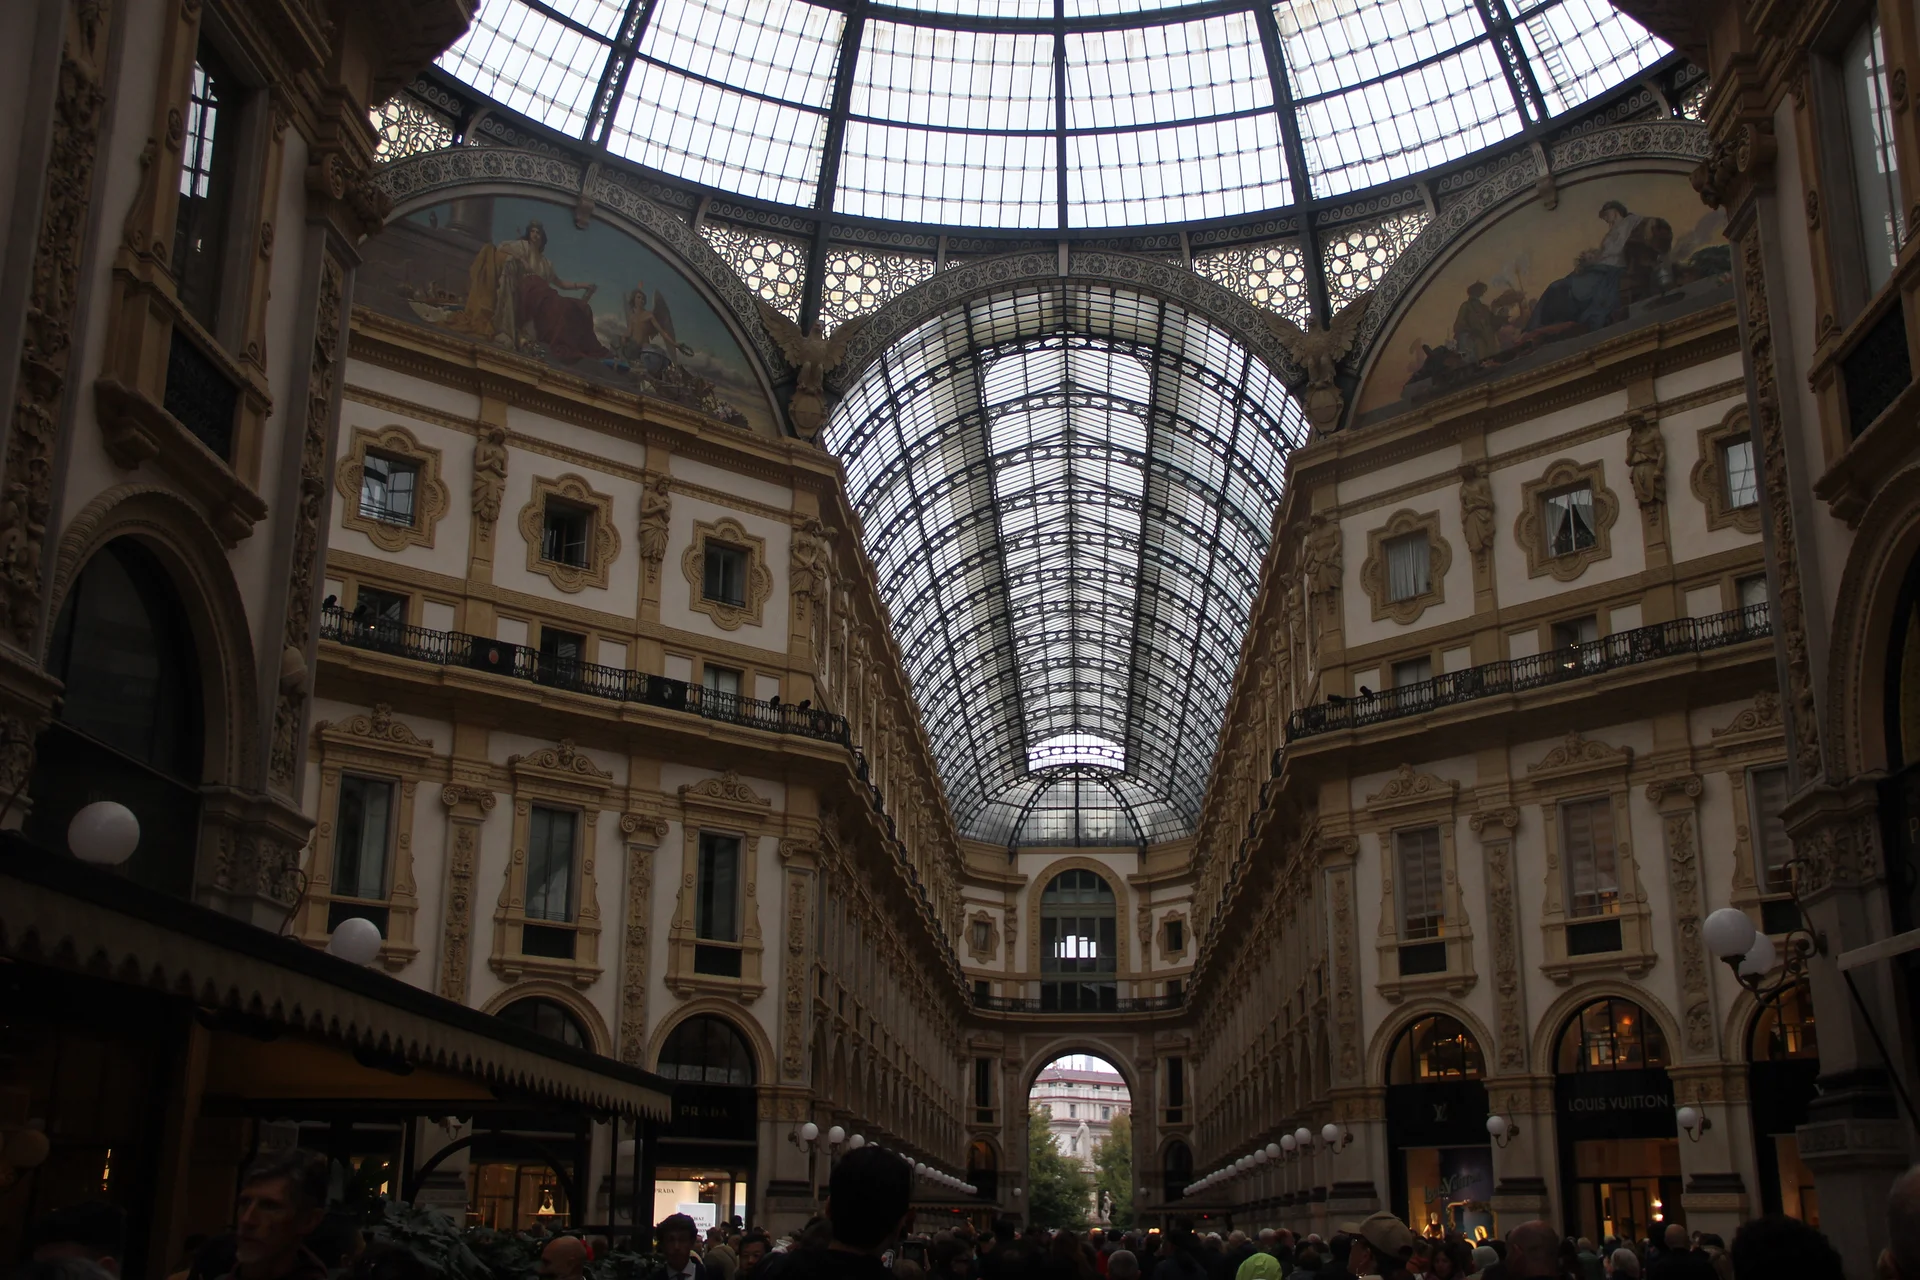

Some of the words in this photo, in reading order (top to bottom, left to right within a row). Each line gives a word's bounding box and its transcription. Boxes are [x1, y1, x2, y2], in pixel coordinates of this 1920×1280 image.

[1568, 1097, 1606, 1112] LOUIS
[1609, 1094, 1669, 1109] VUITTON
[681, 1105, 729, 1118] PRADA
